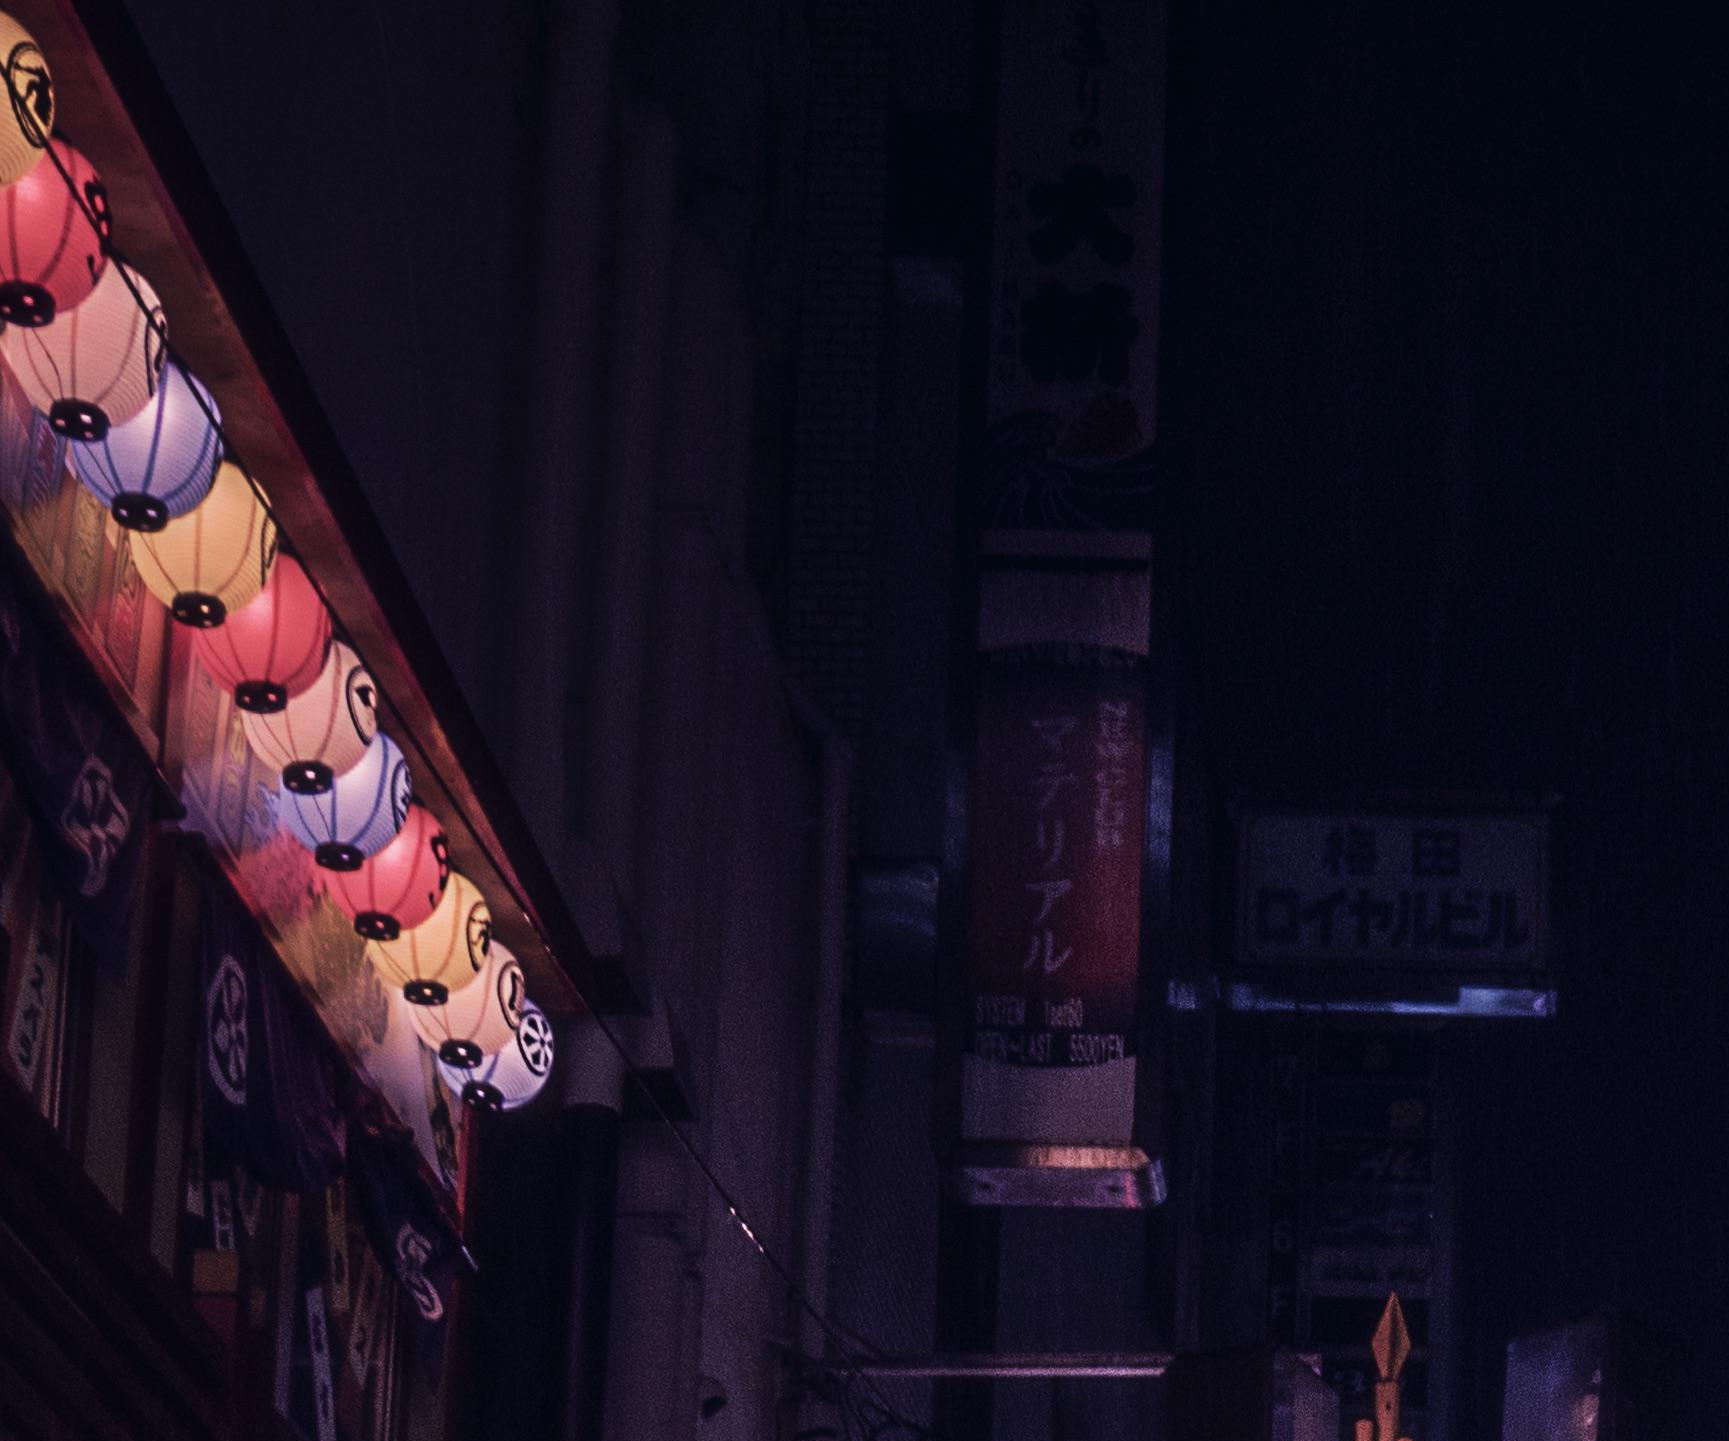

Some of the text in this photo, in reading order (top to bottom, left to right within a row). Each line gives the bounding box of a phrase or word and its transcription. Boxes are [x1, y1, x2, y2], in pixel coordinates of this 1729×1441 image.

[1024, 715, 1080, 975] マテリアル
[1323, 825, 1462, 878] 梅田
[1258, 888, 1531, 949] ロイヤルビル
